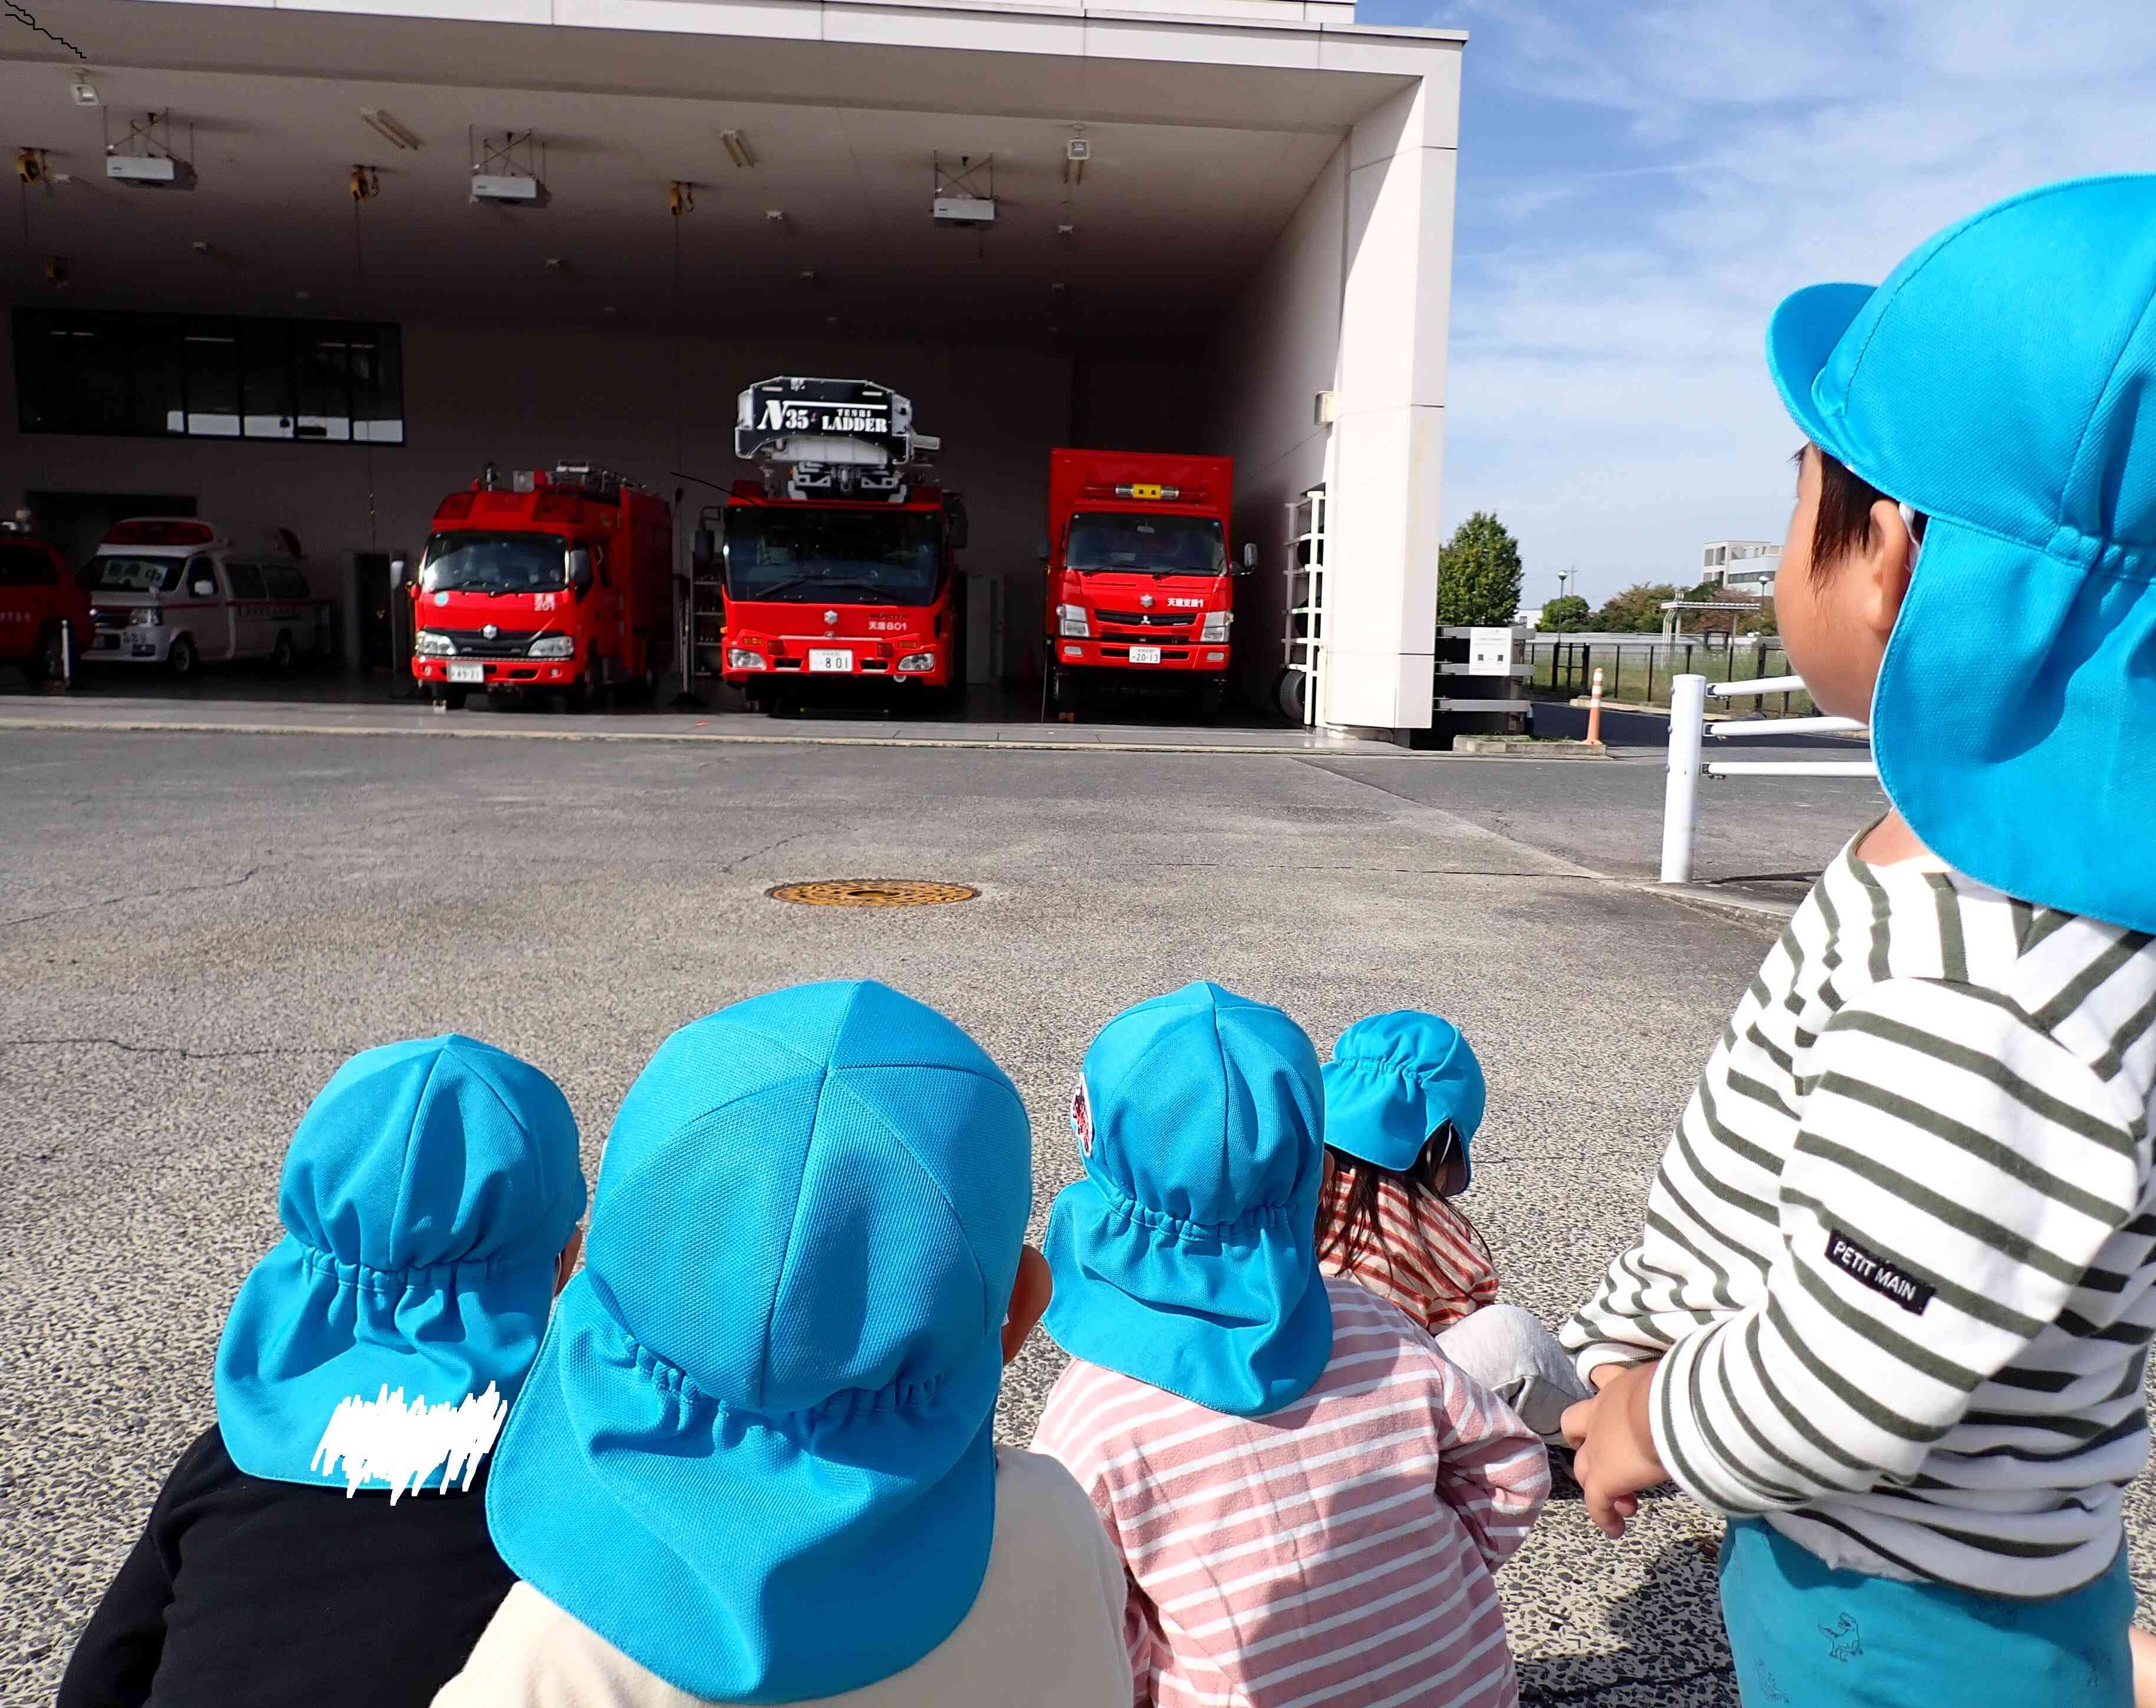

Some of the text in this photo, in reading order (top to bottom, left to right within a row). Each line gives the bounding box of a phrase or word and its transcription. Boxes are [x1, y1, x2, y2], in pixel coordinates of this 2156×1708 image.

[821, 415, 888, 433] LADDER
[1832, 1240, 1916, 1302] PETIT MAIN
